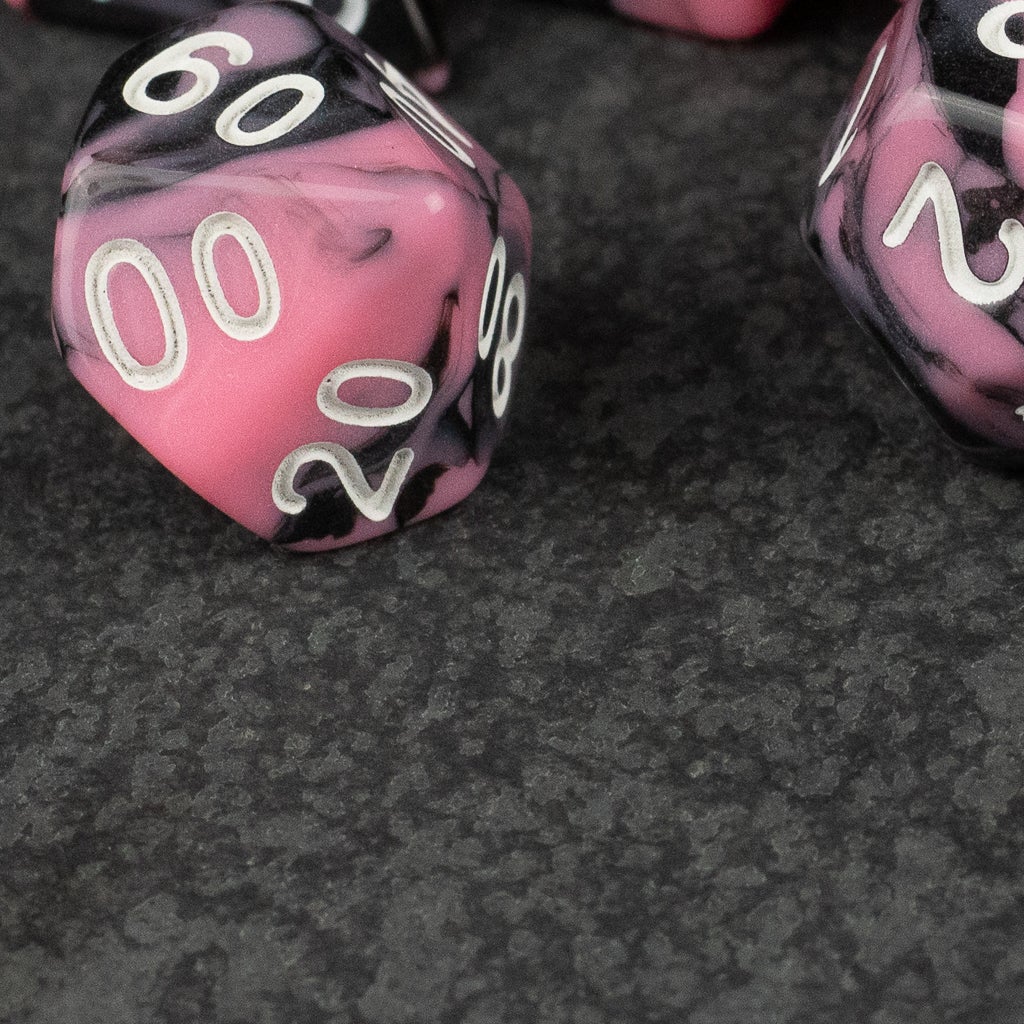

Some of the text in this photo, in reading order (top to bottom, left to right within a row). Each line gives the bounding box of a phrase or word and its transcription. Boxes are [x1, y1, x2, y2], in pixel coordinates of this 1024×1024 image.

[122, 30, 326, 147] 60
[84, 210, 282, 392] 00
[271, 358, 434, 523] 20
